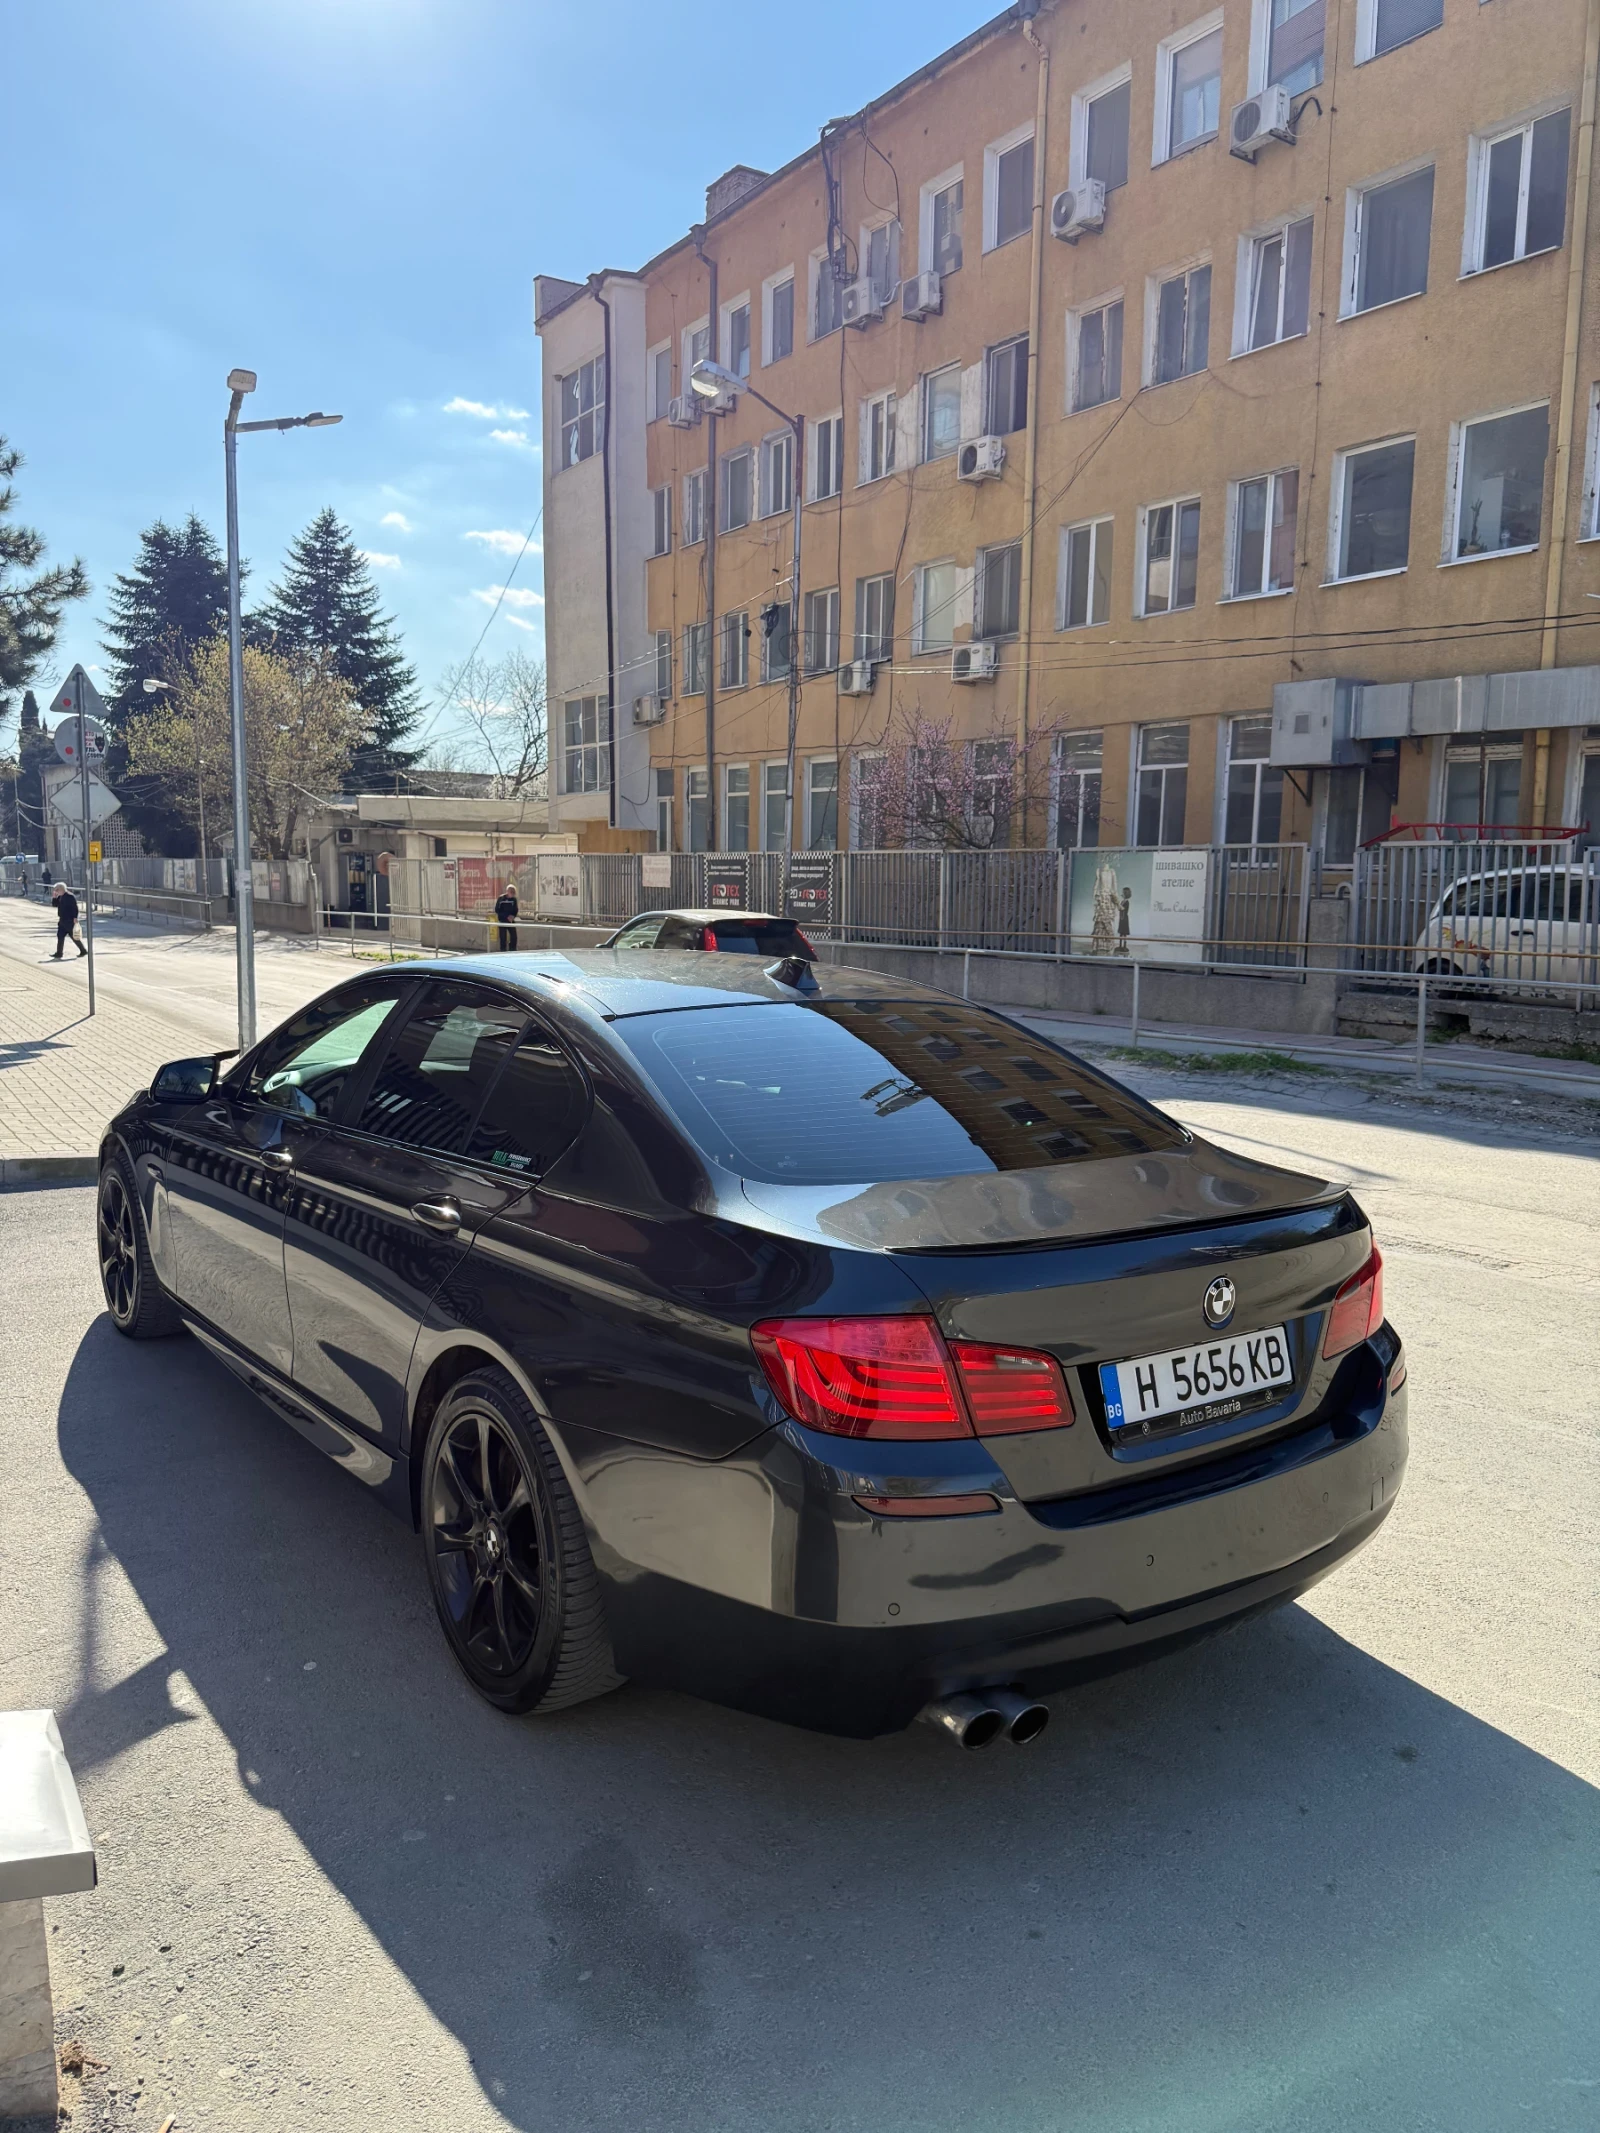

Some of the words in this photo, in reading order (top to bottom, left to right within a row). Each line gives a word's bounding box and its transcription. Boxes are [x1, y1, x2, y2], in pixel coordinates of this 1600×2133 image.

[1155, 861, 1204, 871] шивашко
[1161, 878, 1195, 888] ателие
[1135, 1363, 1160, 1412] H
[1171, 1344, 1245, 1401] 5656
[1246, 1335, 1285, 1383] KB
[1107, 1404, 1123, 1418] BG
[1179, 1412, 1204, 1426] Auto
[1205, 1399, 1242, 1419] Bavaria
